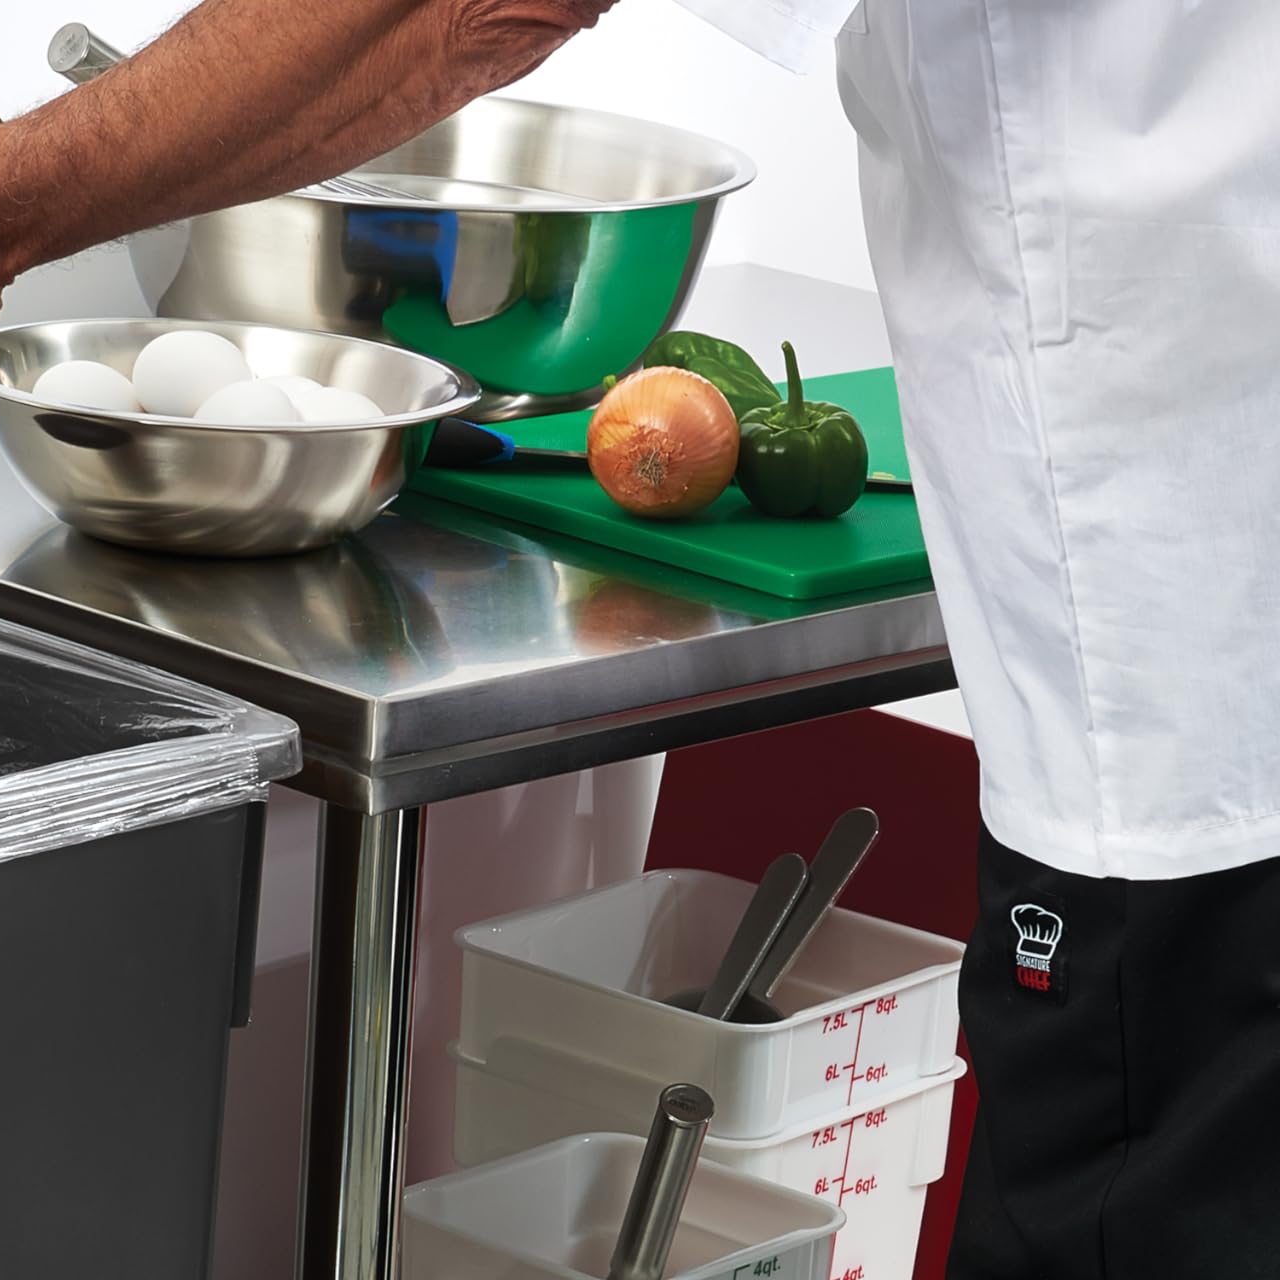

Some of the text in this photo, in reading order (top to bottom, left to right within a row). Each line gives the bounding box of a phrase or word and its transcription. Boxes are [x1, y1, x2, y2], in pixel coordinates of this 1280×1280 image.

[1016, 954, 1050, 972] SIGNATURE
[1016, 966, 1050, 991] CHEF
[875, 994, 898, 1015] 8qt.
[822, 1012, 848, 1034] 7.5L
[825, 1063, 840, 1082] 6L
[866, 1062, 888, 1082] 6qt.
[865, 1107, 888, 1128] 8qt.
[812, 1126, 837, 1149] 7.5L
[815, 1177, 829, 1195] 6L
[855, 1176, 877, 1194] 6qt.
[753, 1256, 781, 1277] 4qt.
